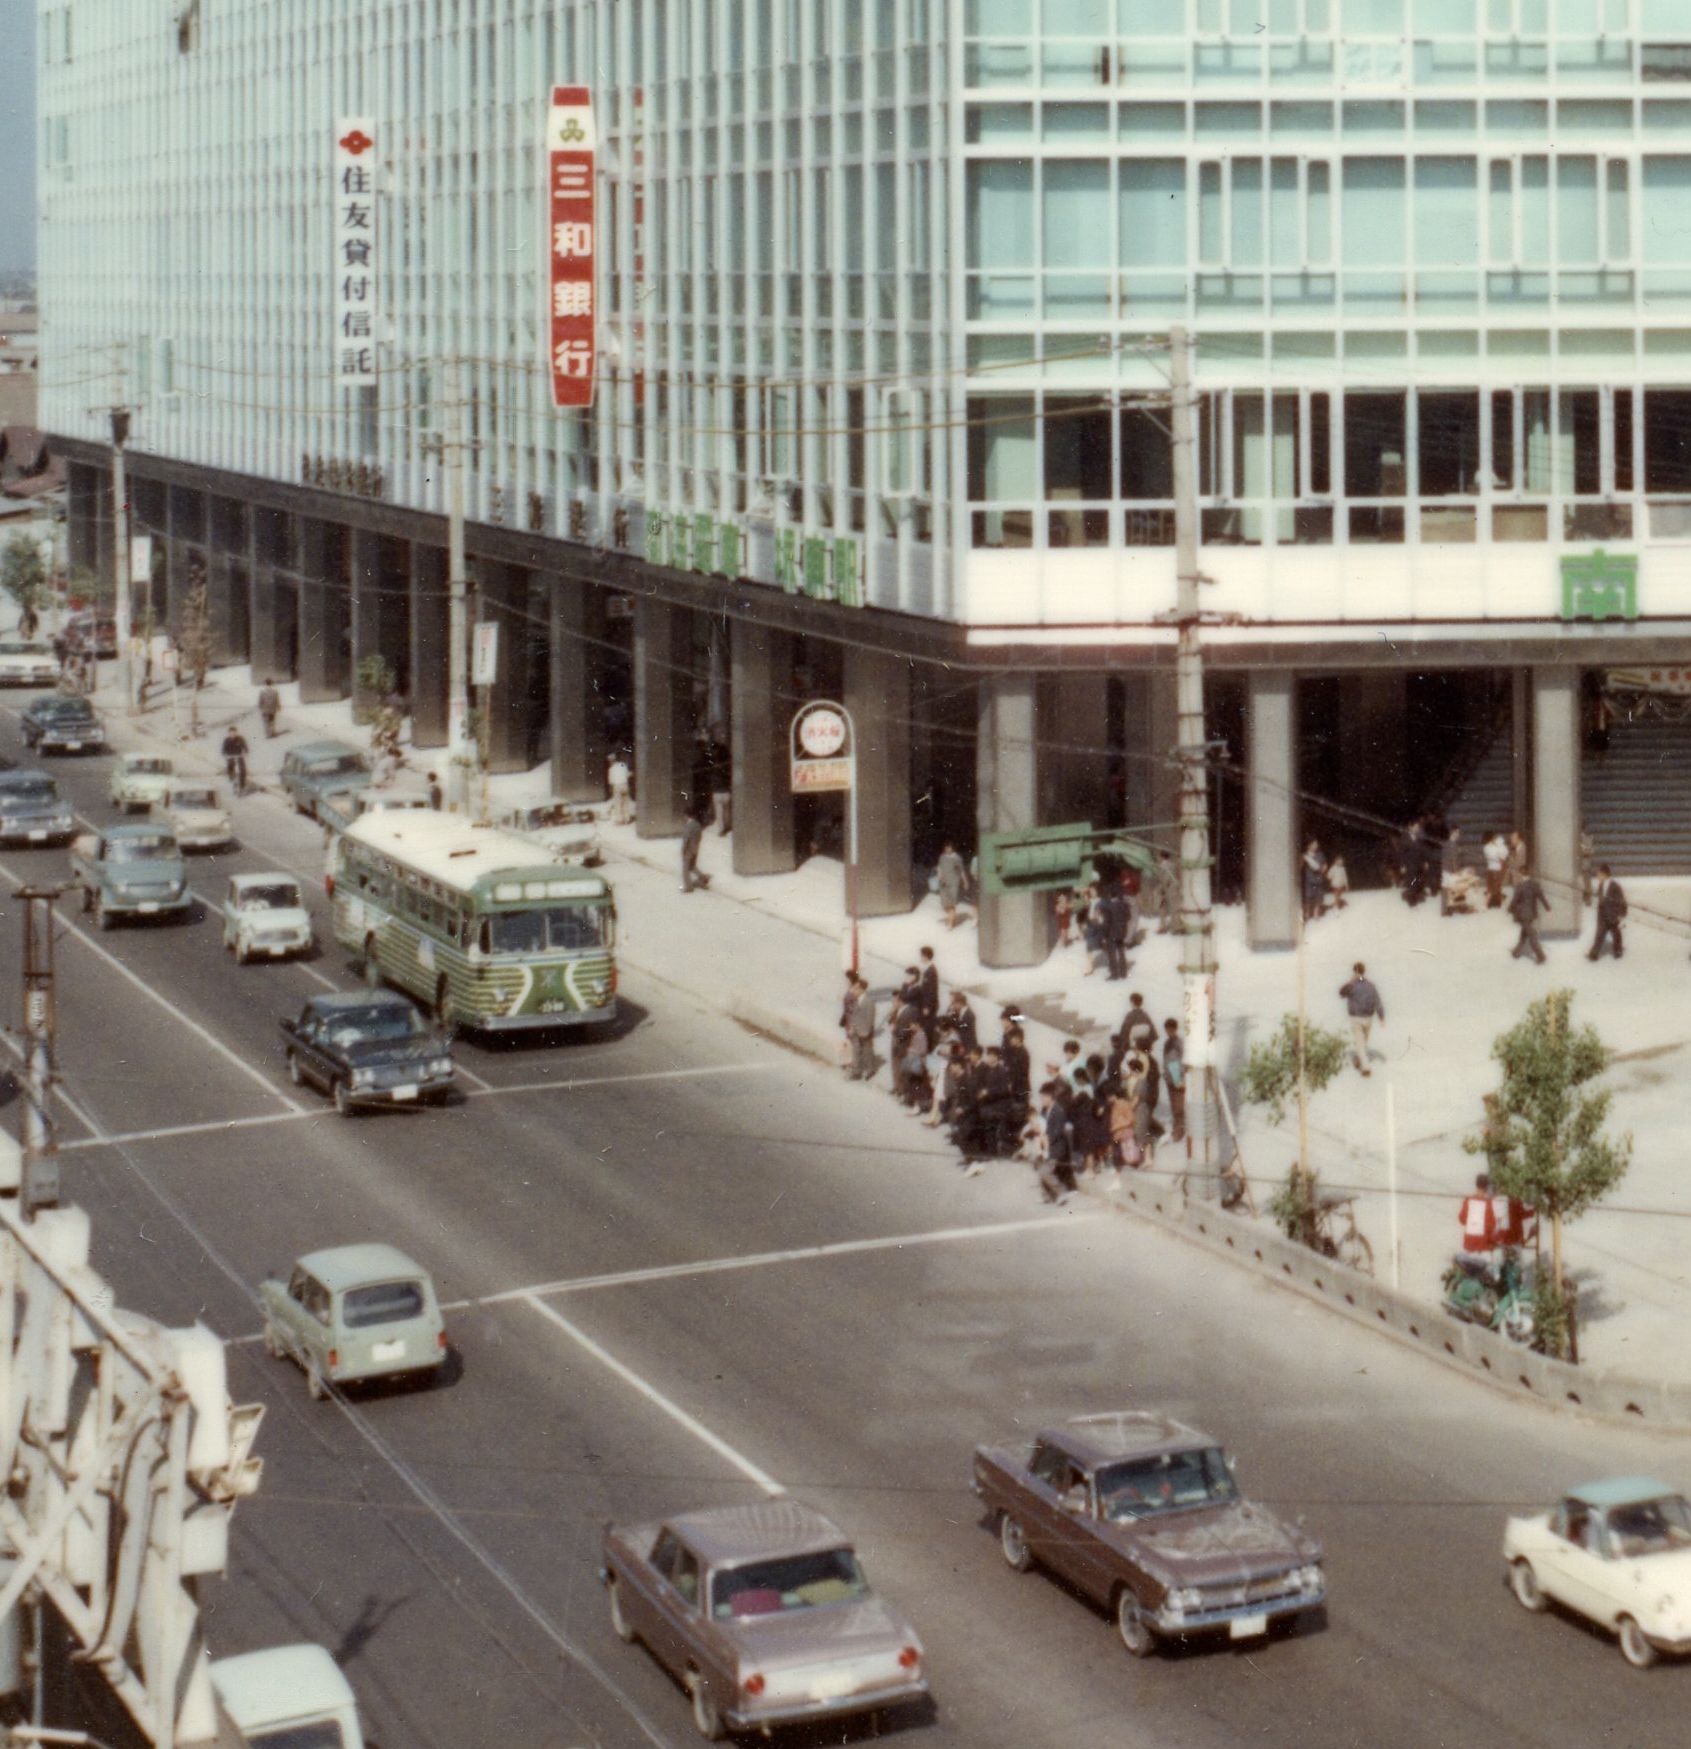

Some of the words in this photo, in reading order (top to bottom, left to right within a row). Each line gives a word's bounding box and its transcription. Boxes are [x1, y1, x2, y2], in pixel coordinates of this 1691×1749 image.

[341, 165, 372, 377] 住友貸付信託
[553, 163, 593, 377] 三和銀行
